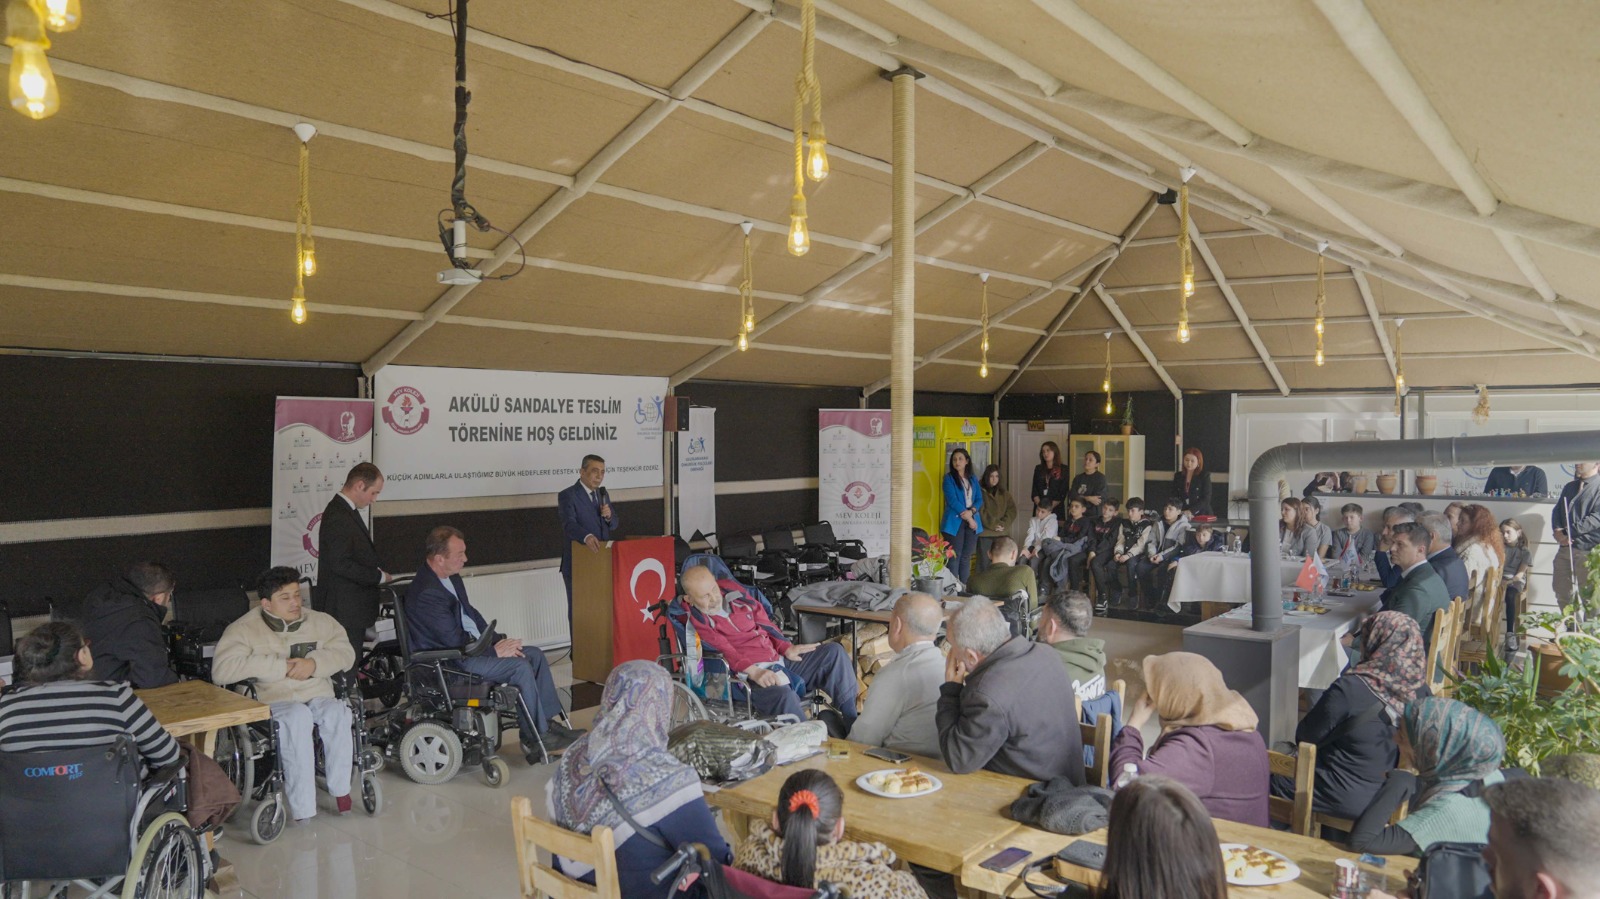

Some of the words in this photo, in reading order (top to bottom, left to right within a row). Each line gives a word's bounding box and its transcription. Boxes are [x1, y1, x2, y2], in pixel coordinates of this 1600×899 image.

[448, 393, 500, 413] AKÜLÜ
[504, 396, 574, 414] SANDALYE
[577, 396, 622, 415] TESLİM
[448, 422, 523, 442] TÖRENİNE
[527, 425, 555, 445] HOŞ
[559, 422, 618, 441] GELDİNİZ
[386, 473, 412, 482] KÜÇÜK
[413, 472, 453, 480] ADIMLARLA
[454, 471, 494, 479] ULAŞTIĞIMIZ
[517, 469, 550, 477] HEDEFLERE
[616, 465, 642, 473] TEŞEKKÜR
[24, 763, 81, 778] COMFORT
